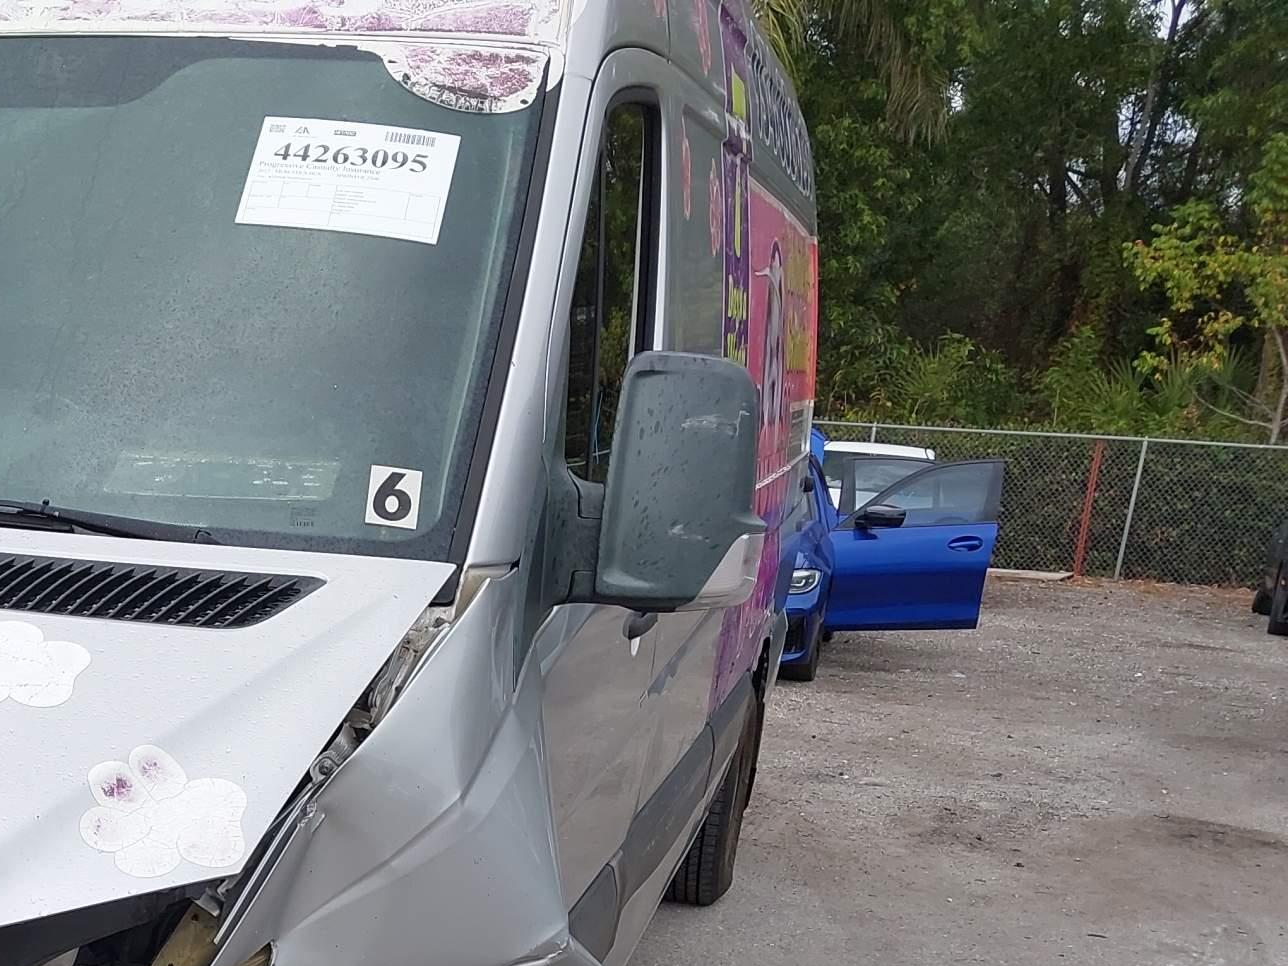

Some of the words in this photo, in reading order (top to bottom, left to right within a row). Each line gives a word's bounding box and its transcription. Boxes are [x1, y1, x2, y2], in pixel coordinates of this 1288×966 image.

[258, 160, 305, 170] Progressive
[342, 165, 381, 175] Insurance
[273, 142, 430, 173] 44263095
[372, 471, 412, 522] 6
